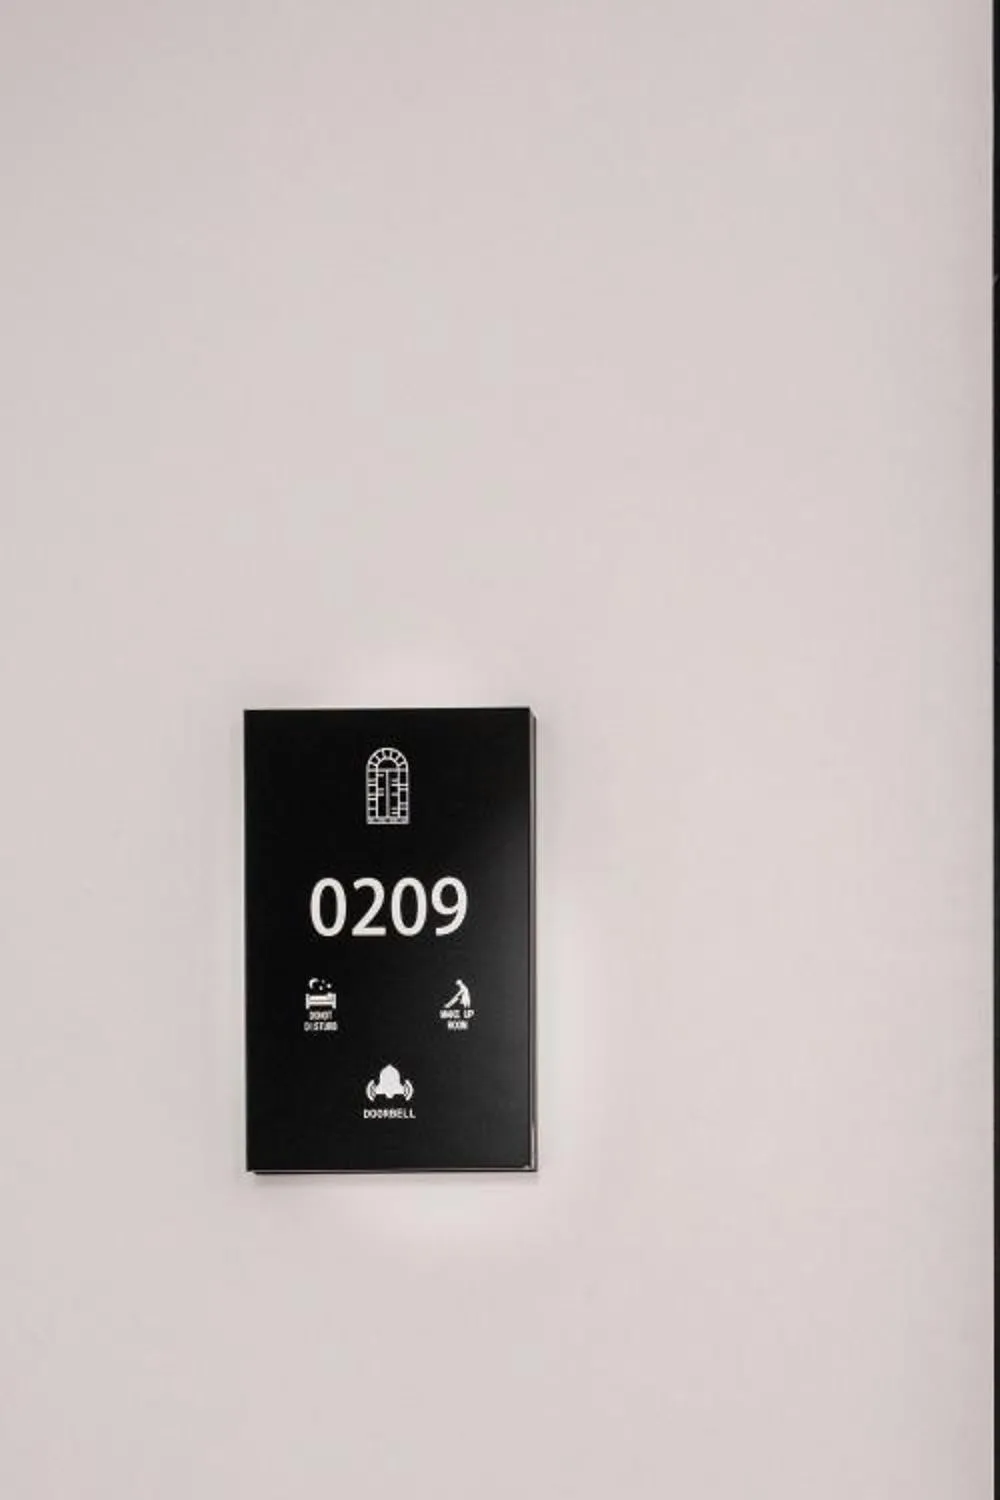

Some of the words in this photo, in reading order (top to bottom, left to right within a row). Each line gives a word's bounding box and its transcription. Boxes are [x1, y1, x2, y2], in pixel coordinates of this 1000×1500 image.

[310, 876, 467, 937] 0209
[463, 1009, 475, 1019] UP
[363, 1108, 416, 1119] DOORBELL
